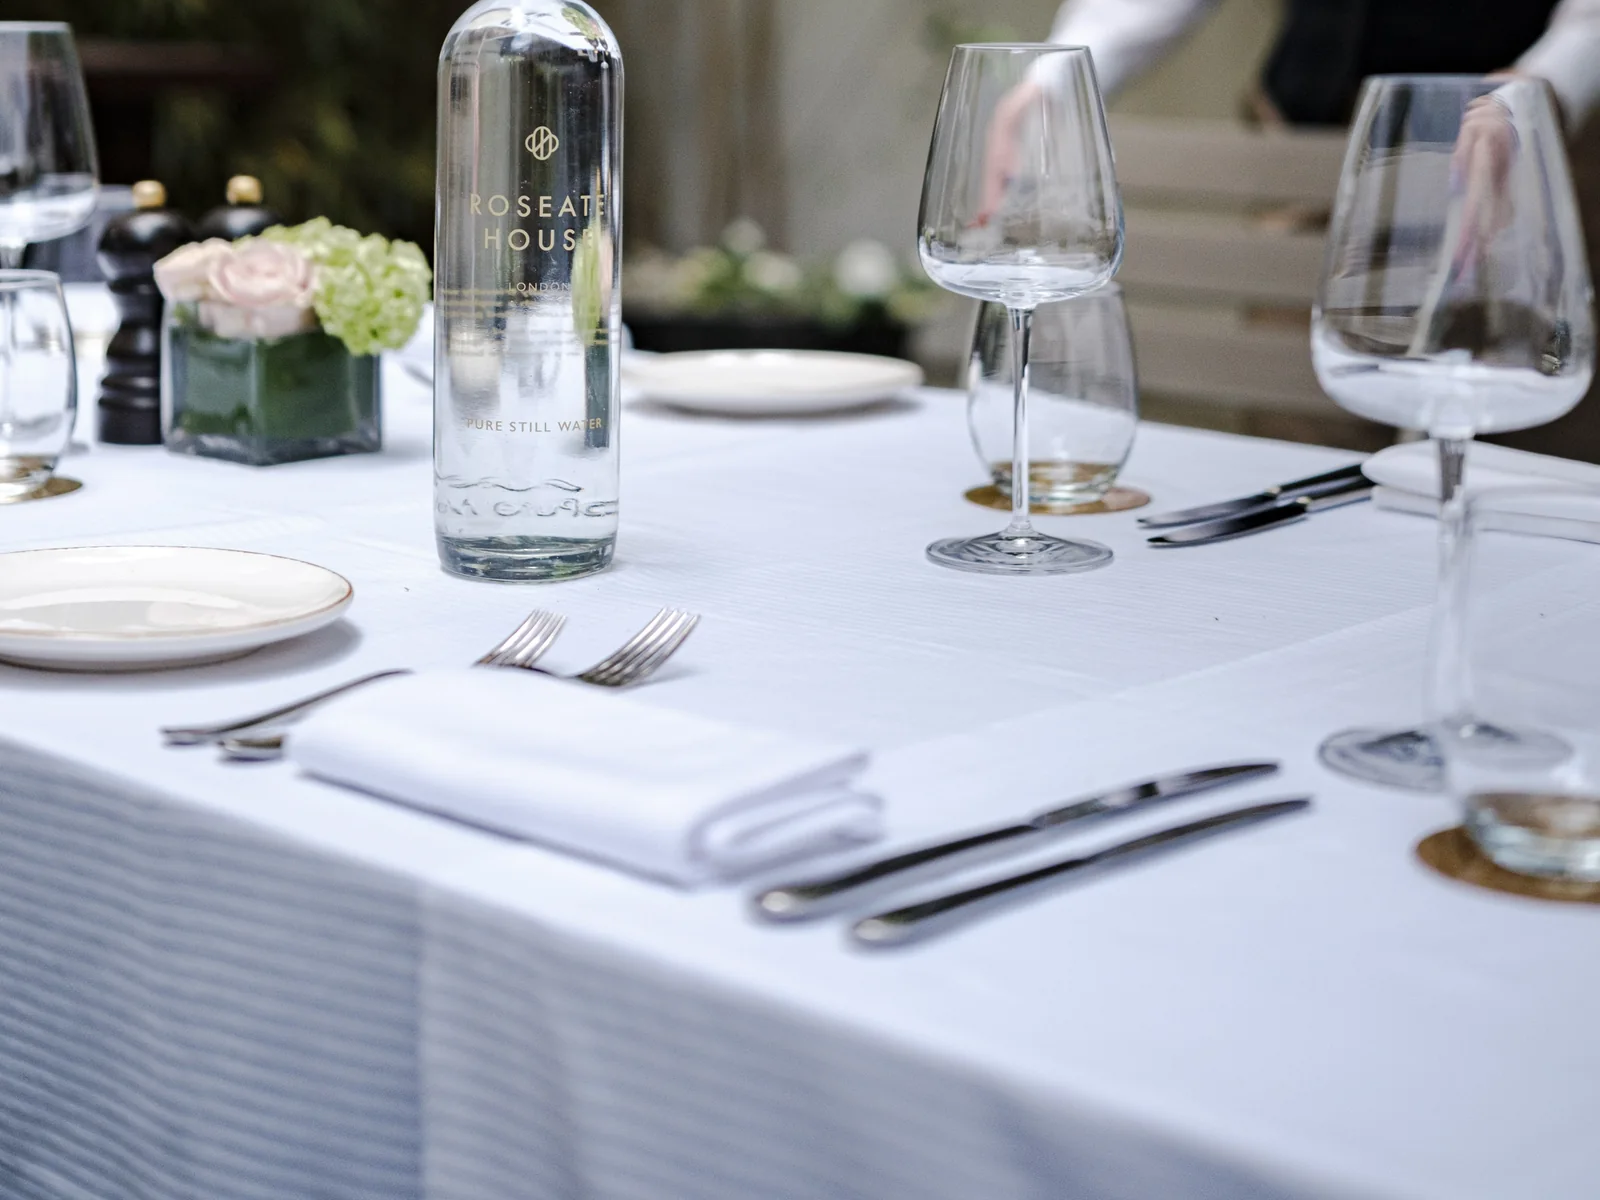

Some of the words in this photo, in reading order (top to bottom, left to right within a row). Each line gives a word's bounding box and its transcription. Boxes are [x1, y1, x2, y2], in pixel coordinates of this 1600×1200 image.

[469, 193, 605, 218] ROSEATE
[484, 228, 594, 252] HOUSE
[508, 282, 570, 292] LONDON
[467, 418, 503, 431] PURE
[509, 420, 551, 433] STILL
[557, 417, 602, 431] WATER
